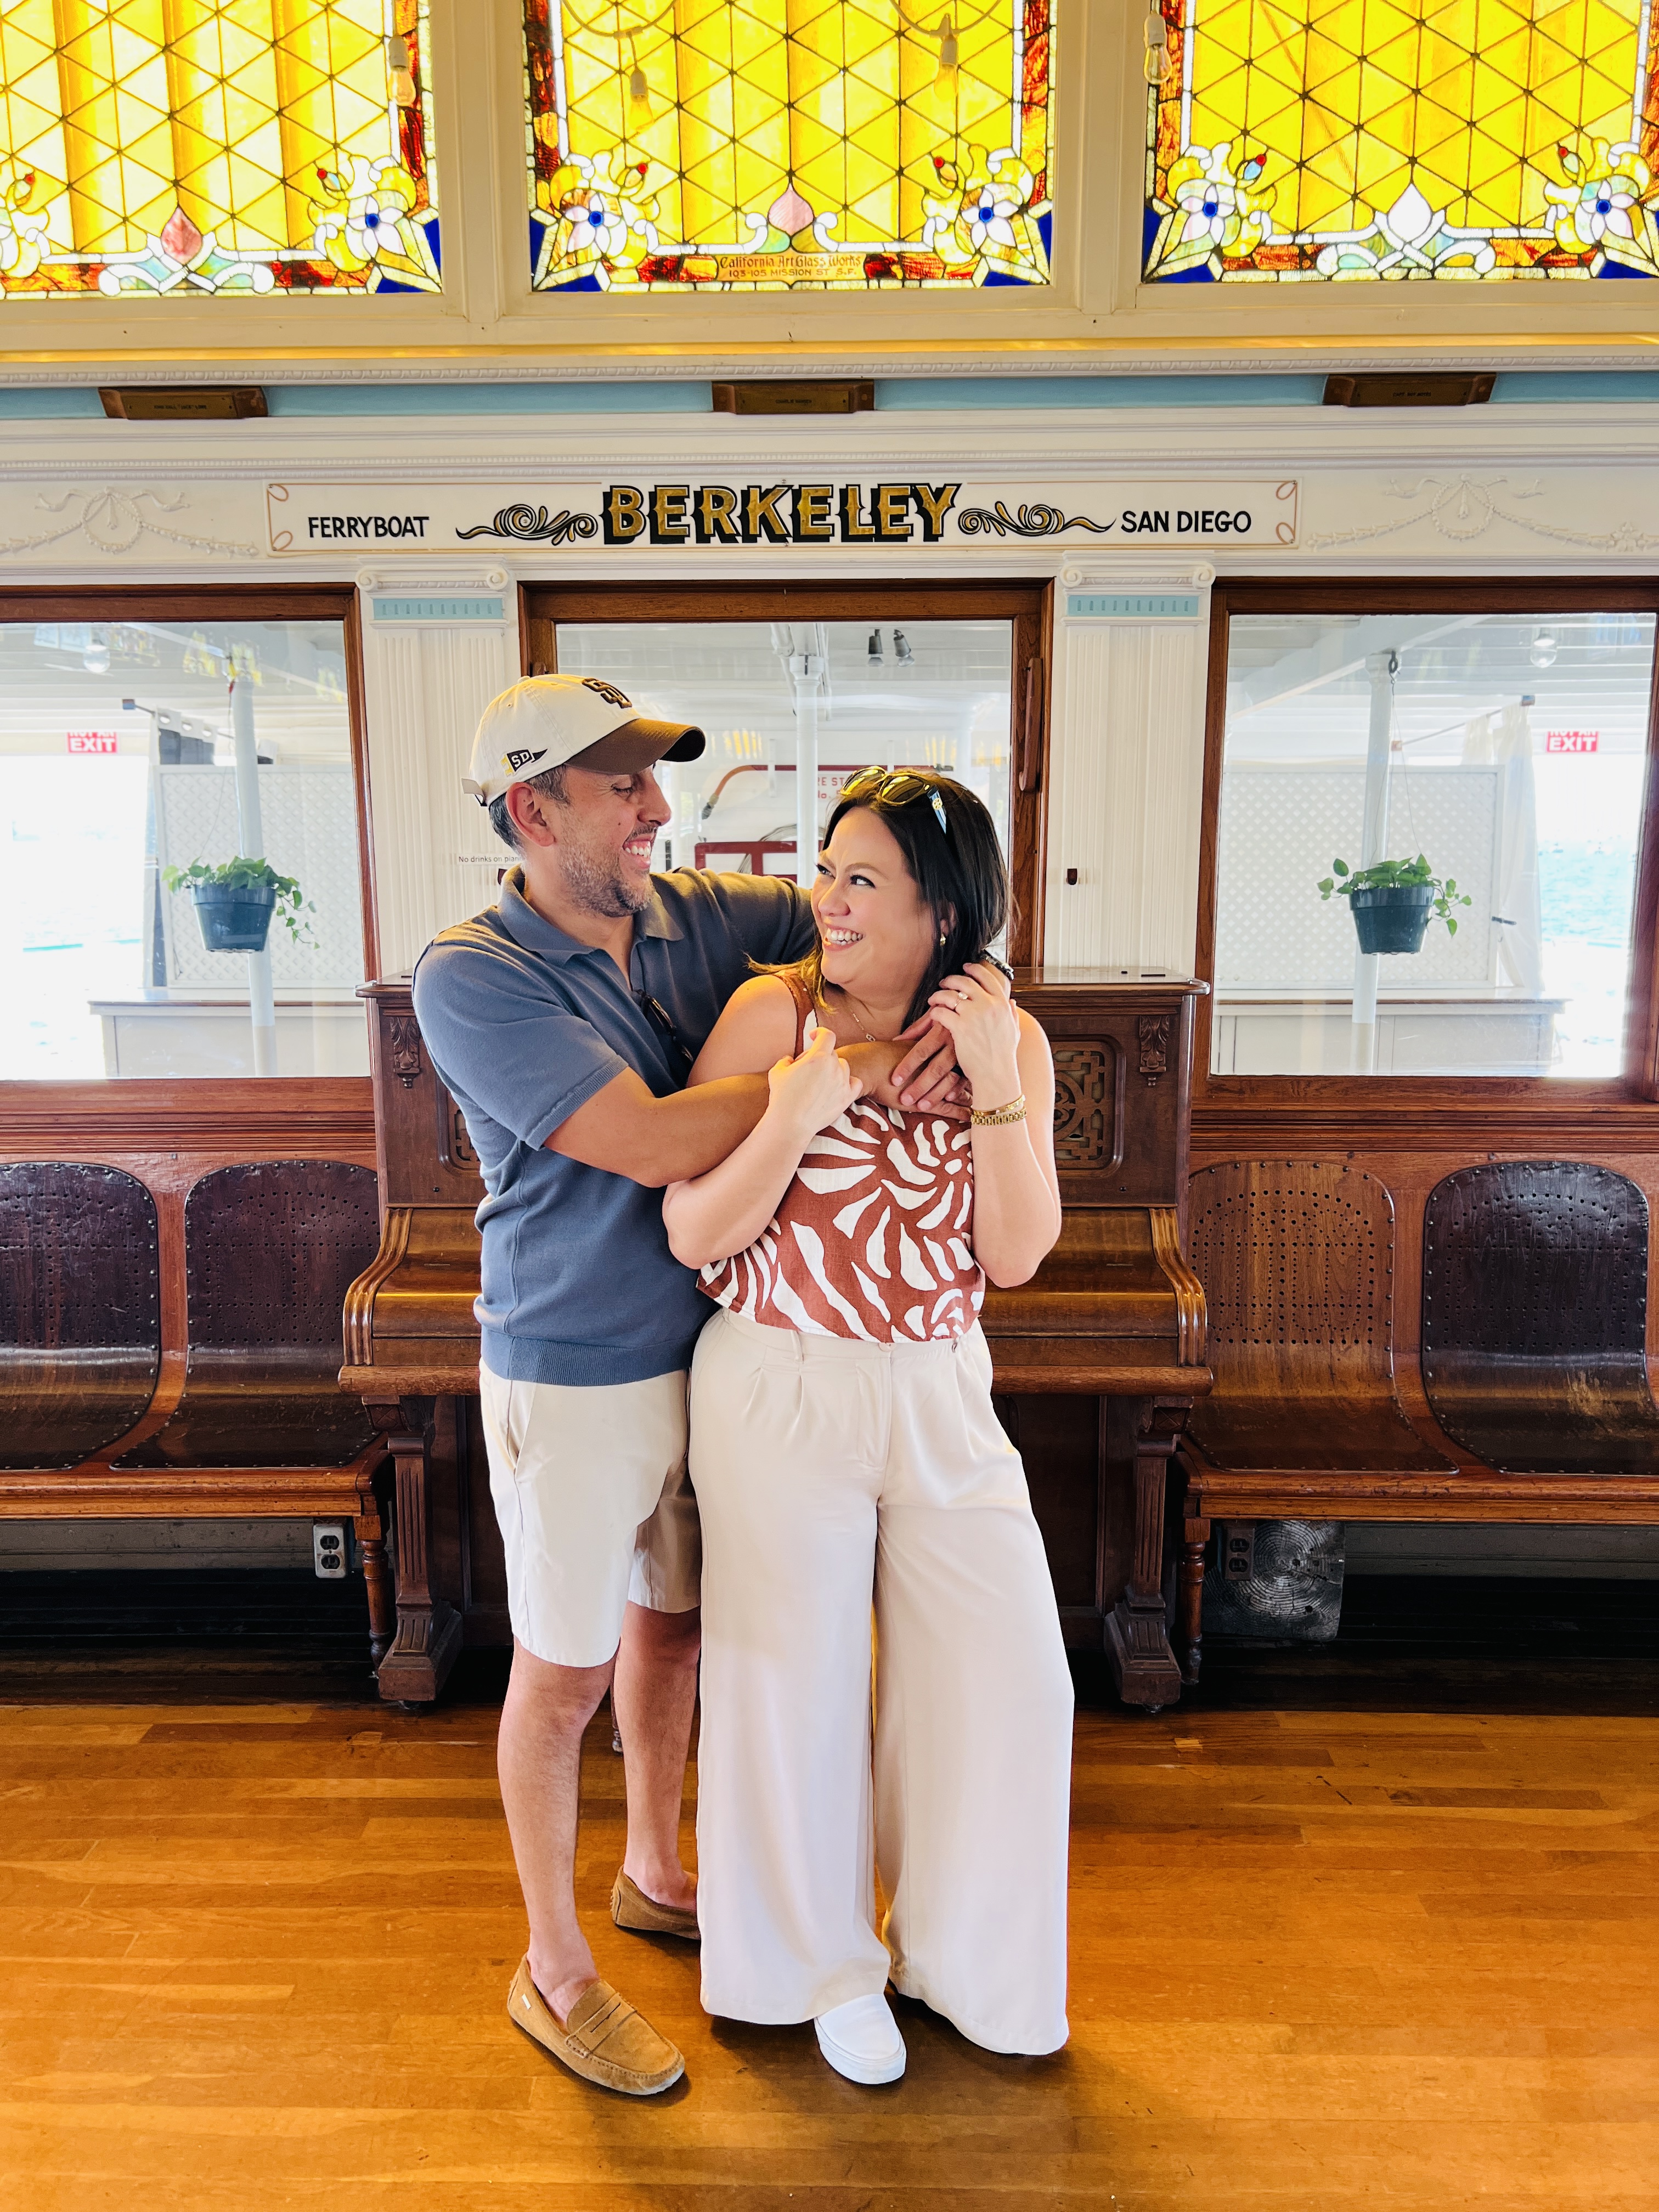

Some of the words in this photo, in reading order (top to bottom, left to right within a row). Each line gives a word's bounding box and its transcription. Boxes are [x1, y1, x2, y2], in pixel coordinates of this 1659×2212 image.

[720, 256, 774, 268] California
[828, 254, 861, 267] Works
[770, 268, 811, 276] MISSION
[836, 268, 857, 276] S.F.
[600, 483, 962, 545] BERKELEY
[1121, 510, 1169, 533] SAN
[1177, 510, 1251, 533] DIEGO
[308, 516, 429, 538] FERRYBOAT
[70, 737, 115, 752] EXIT
[1549, 737, 1596, 751] EXIT
[511, 752, 530, 768] SD
